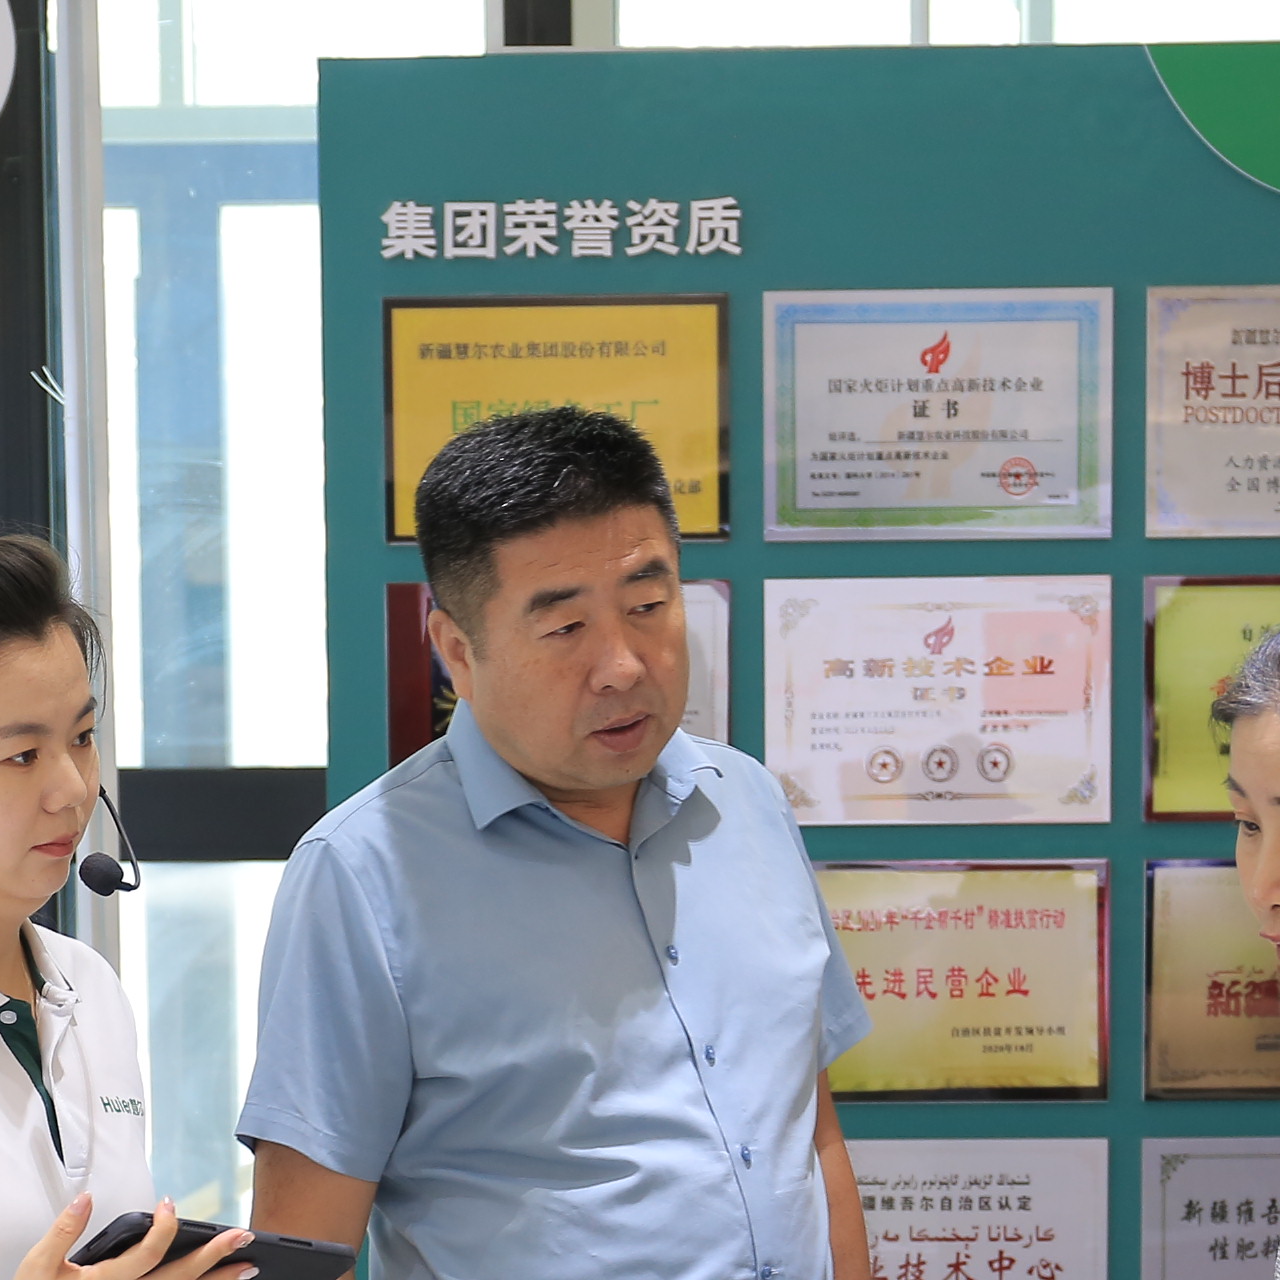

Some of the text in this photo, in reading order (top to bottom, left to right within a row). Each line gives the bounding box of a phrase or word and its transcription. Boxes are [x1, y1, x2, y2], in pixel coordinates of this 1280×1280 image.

[380, 196, 743, 260] 集团荣誉资质
[418, 340, 667, 360] 新疆慧尔农业集团股份有限公司
[828, 377, 1044, 394] 国家火炬计划重点高新技术企业
[912, 399, 960, 419] 证书
[823, 656, 1056, 679] 高新技术企业
[912, 686, 966, 701] 证书
[856, 966, 1030, 1000] 先进民营企业
[863, 1196, 1032, 1212] 疆维吾尔自治区认定
